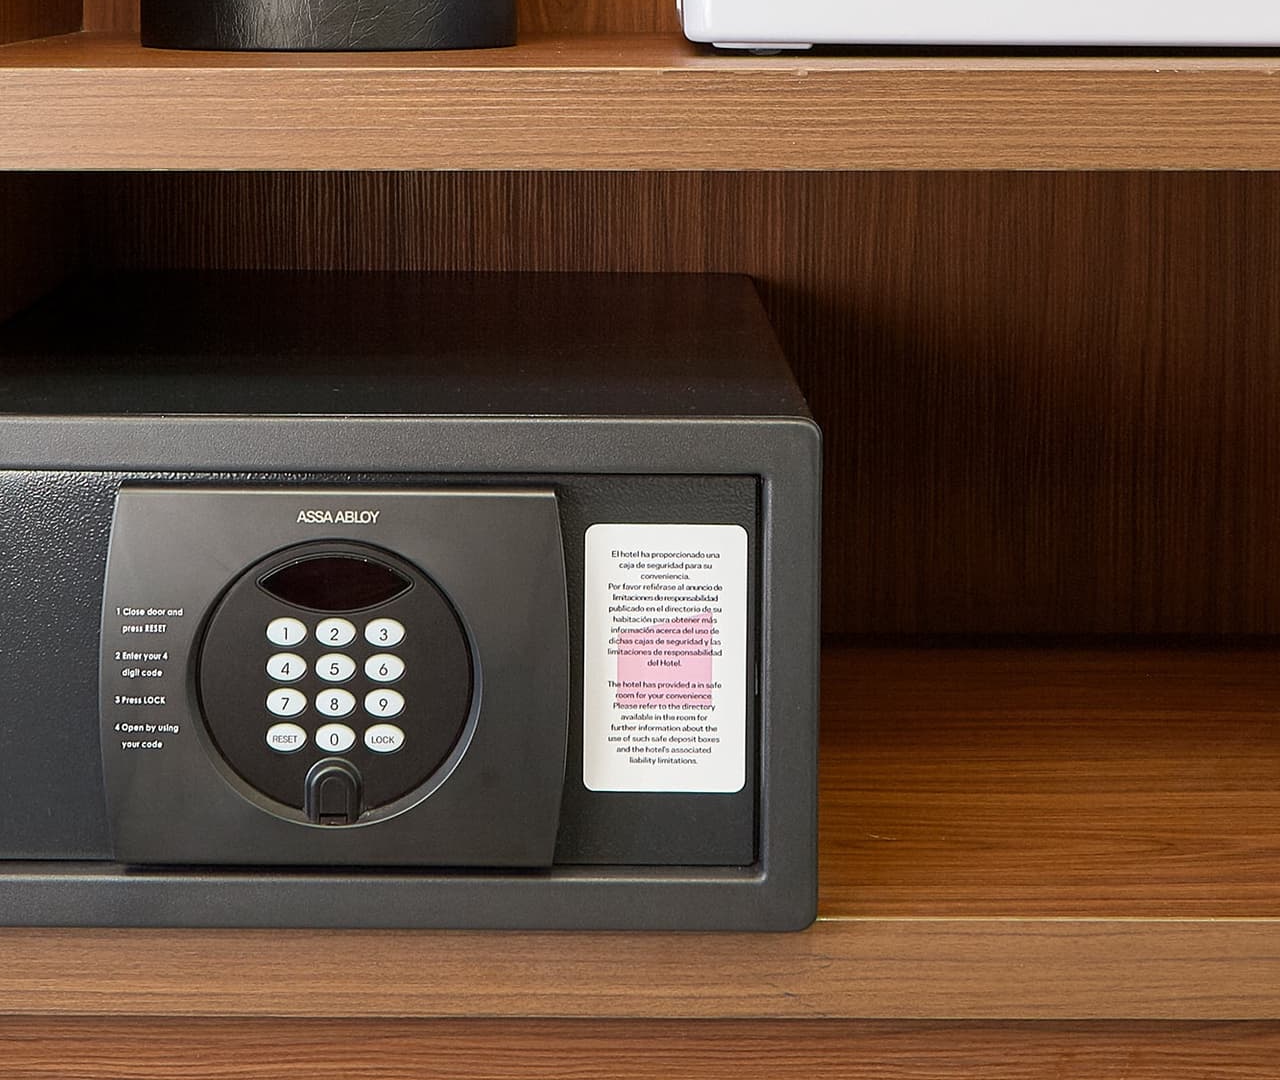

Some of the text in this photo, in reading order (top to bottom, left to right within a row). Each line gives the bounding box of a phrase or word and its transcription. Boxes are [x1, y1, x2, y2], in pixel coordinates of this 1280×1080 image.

[296, 510, 380, 524] ASSA ABLOY
[651, 551, 705, 559] proporcionado
[619, 562, 634, 570] caja
[647, 562, 683, 570] seguridad
[116, 608, 183, 616] 1 Close door and
[609, 605, 644, 613] publicado
[122, 624, 166, 634] press RESET
[283, 627, 287, 640] 1
[330, 628, 338, 641] 2
[379, 628, 388, 641] 3
[666, 638, 704, 646] seguridad
[115, 652, 168, 662] 2 Enter your 4
[664, 649, 722, 657] responsabilidad
[122, 669, 162, 678] digit code
[281, 662, 289, 675] 4
[330, 663, 339, 675] 5
[379, 664, 388, 675] 6
[657, 681, 690, 689] provided
[115, 696, 166, 704] 3 Press LOCK
[281, 698, 289, 710] 7
[330, 698, 338, 710] 8
[379, 698, 388, 711] 9
[121, 724, 144, 733] Open
[146, 724, 156, 734] by
[158, 725, 179, 734] using
[330, 734, 338, 745] 0
[371, 736, 395, 744] LOCK
[122, 741, 140, 749] your
